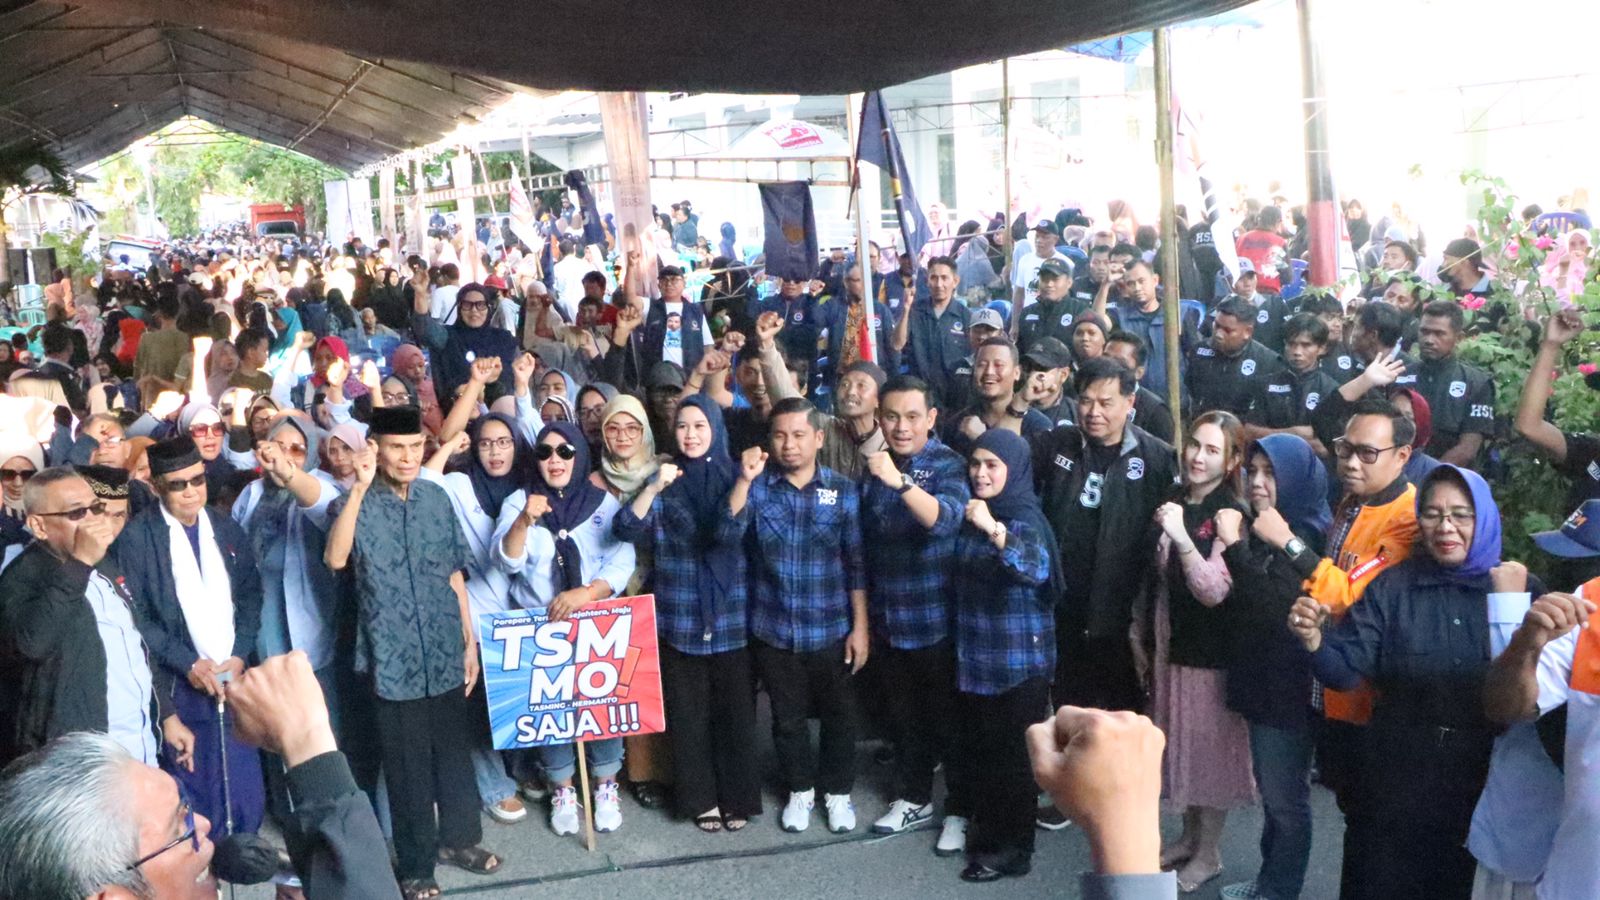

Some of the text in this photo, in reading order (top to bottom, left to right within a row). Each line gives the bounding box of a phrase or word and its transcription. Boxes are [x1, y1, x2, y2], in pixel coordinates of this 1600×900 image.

[816, 488, 838, 498] TSM
[819, 497, 837, 505] MO
[533, 615, 549, 623] Ter
[611, 605, 632, 615] Maju
[492, 614, 633, 671] TSM
[528, 702, 566, 712] TASMING
[572, 697, 618, 709] HERMANTO
[516, 709, 602, 743] SAJA
